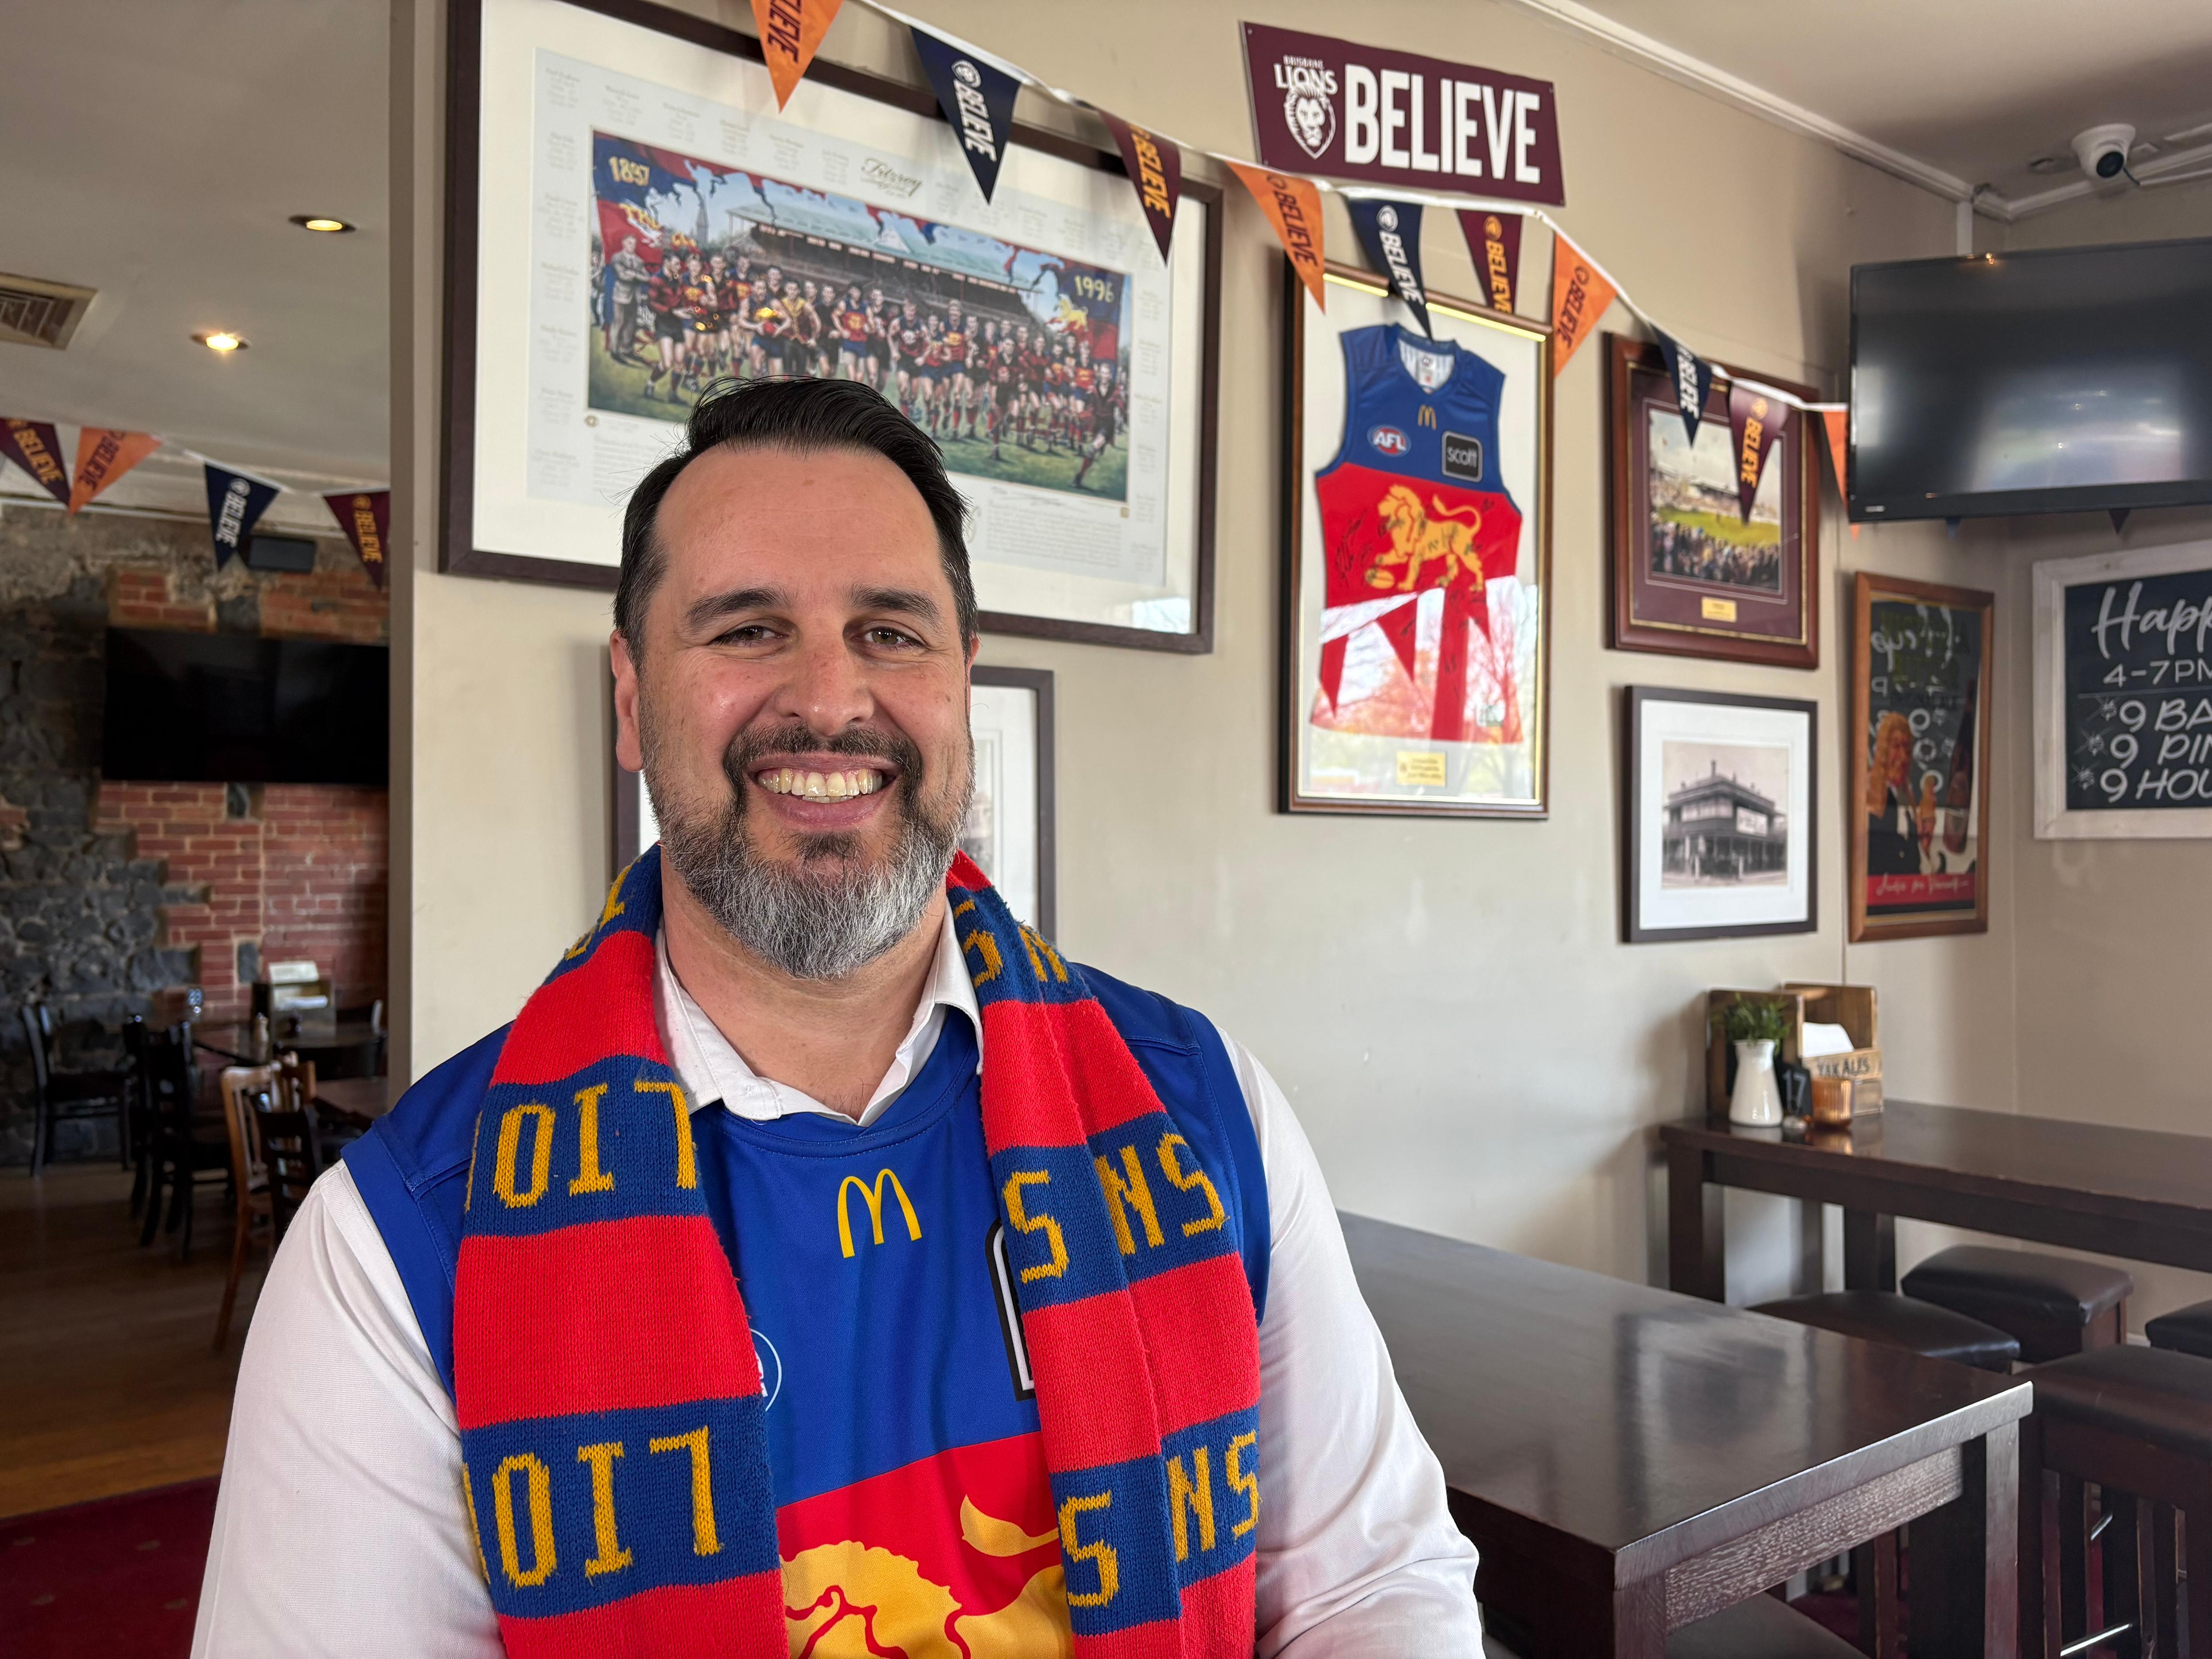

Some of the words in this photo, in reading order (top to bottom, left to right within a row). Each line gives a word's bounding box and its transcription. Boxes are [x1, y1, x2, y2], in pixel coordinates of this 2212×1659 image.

[1274, 62, 1338, 95] LIONS
[953, 78, 997, 162] BELIEVE
[1345, 63, 1540, 183] BELIEVE
[1131, 134, 1171, 219] BELIEVE
[1273, 190, 1318, 267] BELIEVE
[1074, 275, 1114, 303] 1996
[1379, 230, 1425, 305] BELIEVE
[1557, 279, 1586, 348] BELIEVE
[1677, 355, 1700, 419] BELIEVE
[13, 427, 64, 484] BELIEVE
[1373, 431, 1407, 451] AFL
[1447, 445, 1478, 468] scott
[1741, 418, 1763, 488] BELIEVE
[215, 491, 247, 548] BELIEVE
[355, 510, 382, 563] BELIEVE
[2154, 698, 2212, 731] BA
